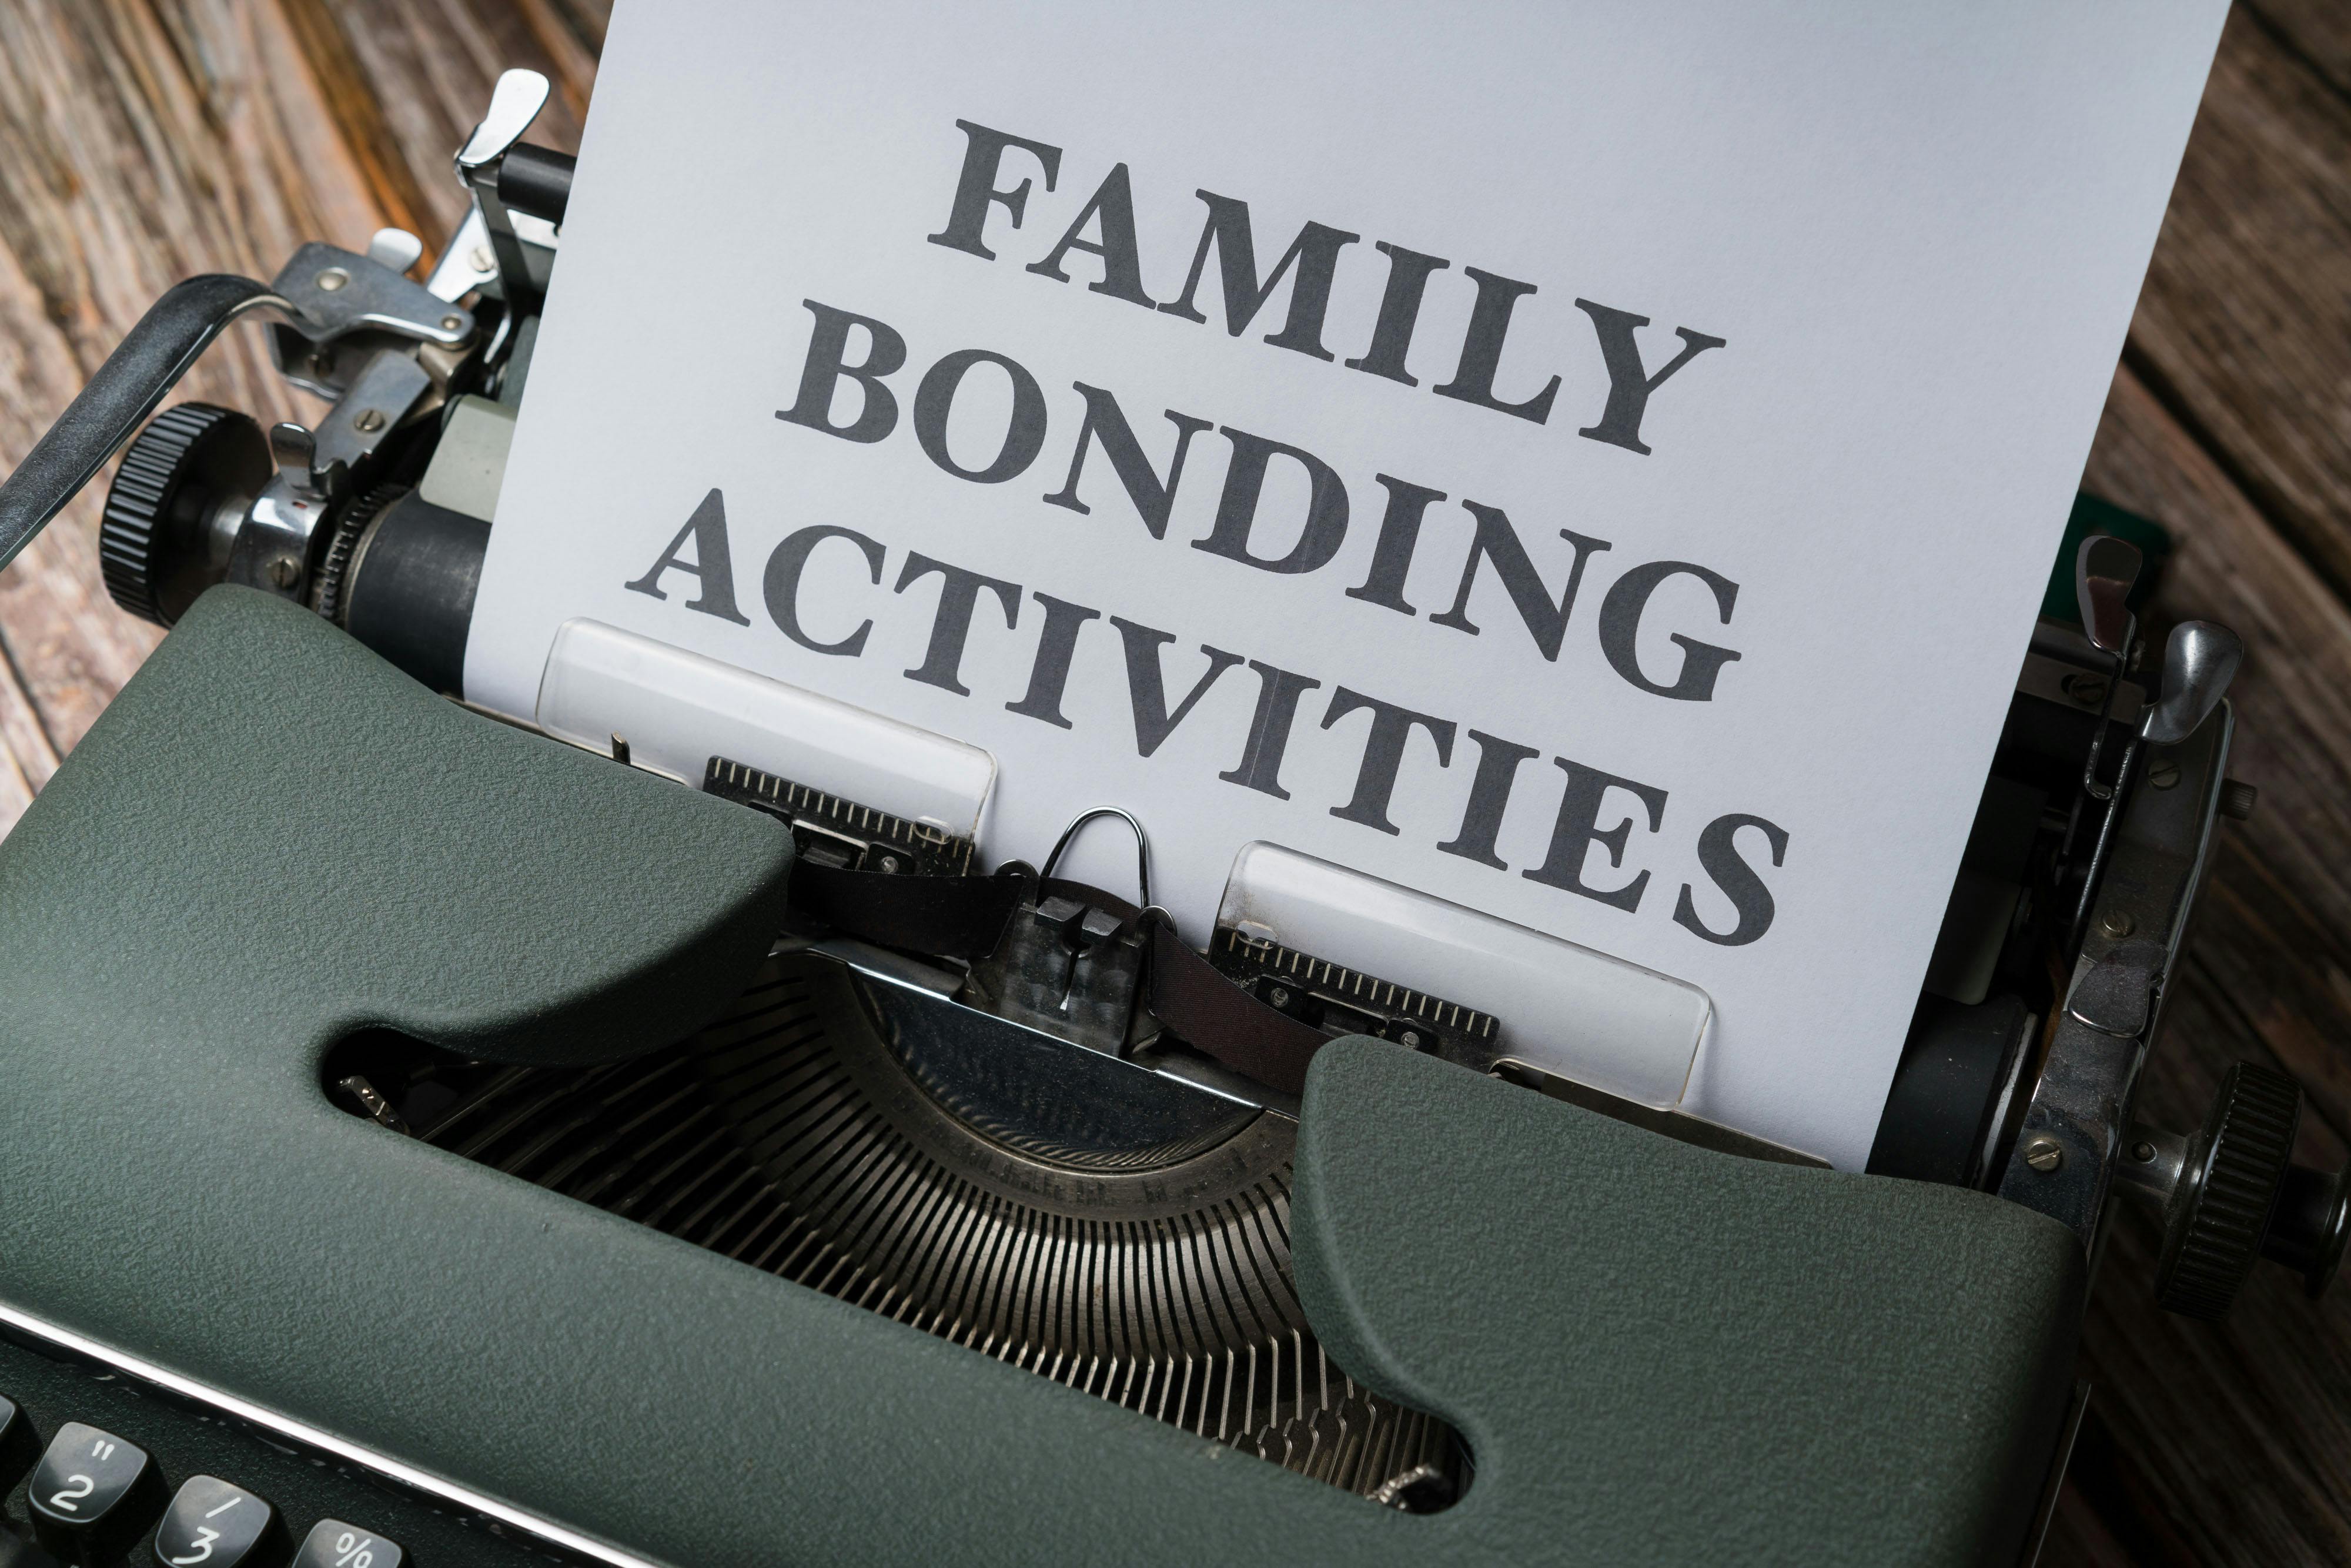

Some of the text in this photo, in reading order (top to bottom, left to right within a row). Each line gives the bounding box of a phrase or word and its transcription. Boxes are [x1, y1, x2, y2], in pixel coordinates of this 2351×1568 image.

[927, 118, 1727, 456] FAMILY
[775, 298, 1742, 702] BONDING
[624, 488, 1790, 947] ACTIVITIES
[50, 1473, 94, 1512] 2
[171, 1526, 220, 1566] 3
[335, 1532, 374, 1568] %
